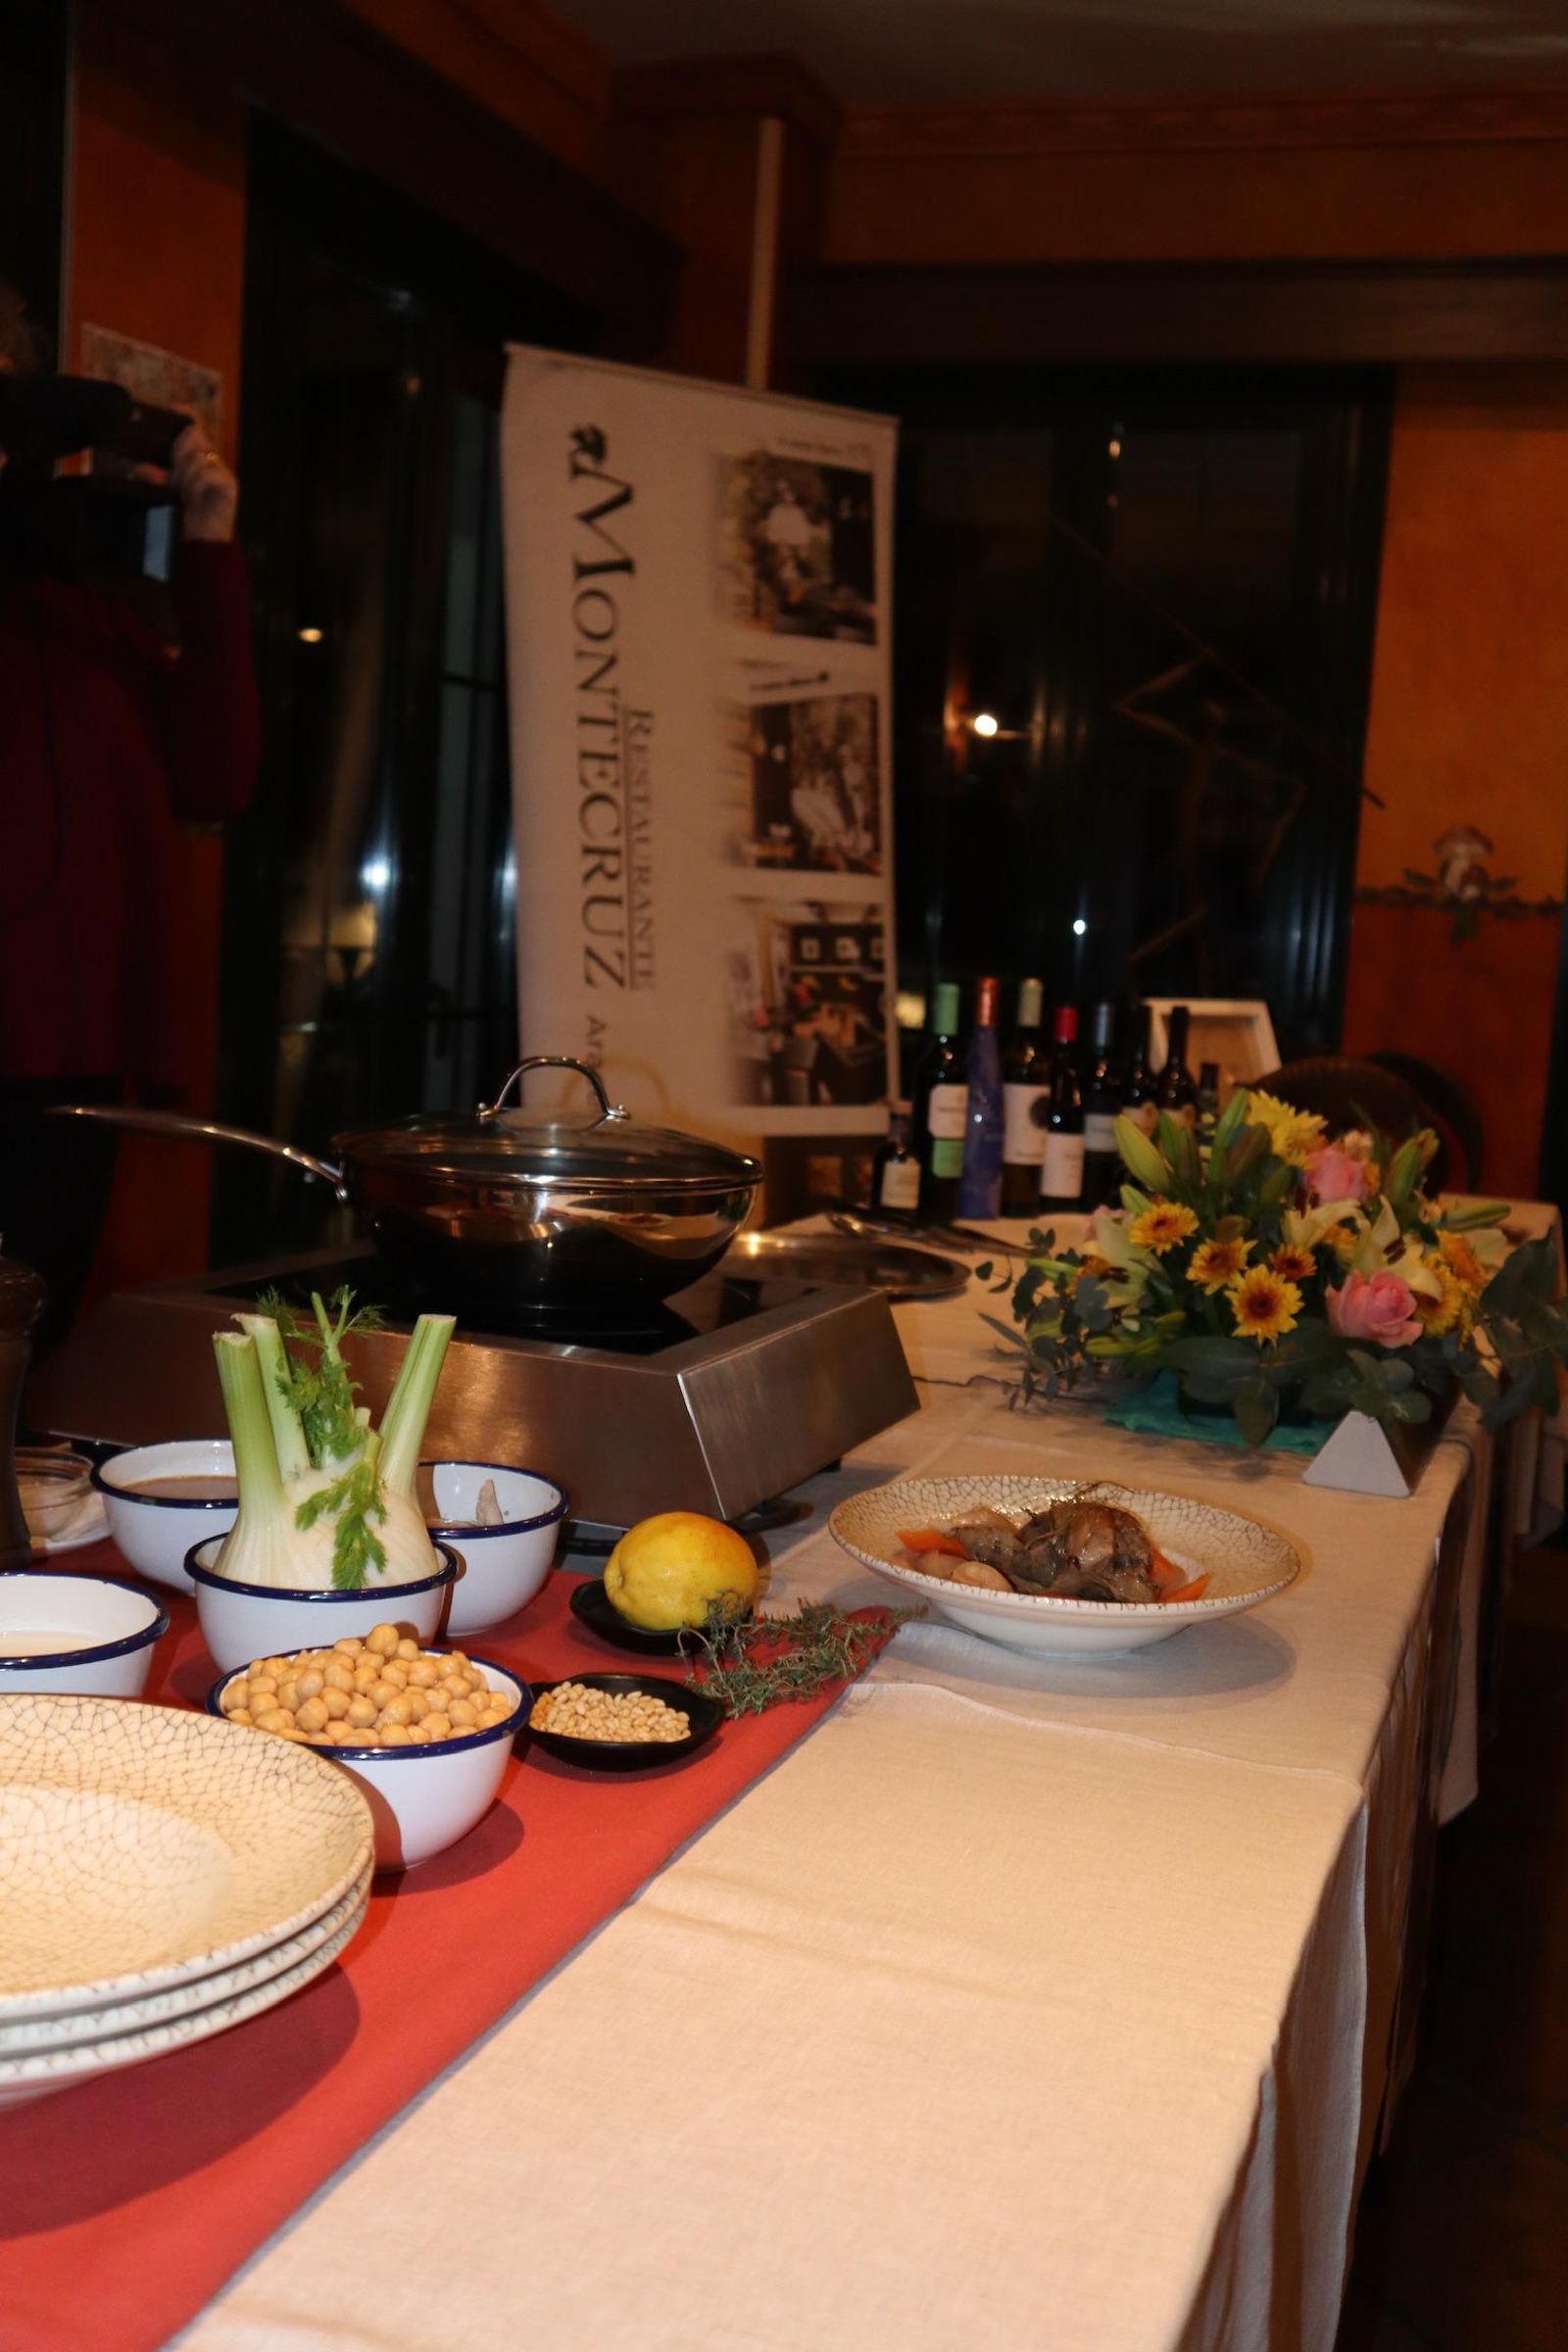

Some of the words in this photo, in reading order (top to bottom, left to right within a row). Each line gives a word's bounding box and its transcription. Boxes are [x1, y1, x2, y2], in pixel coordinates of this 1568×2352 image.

[570, 453, 635, 989] MONTECRUZ
[630, 707, 655, 989] RESTAURANTE
[586, 1013, 607, 1071] Ara
